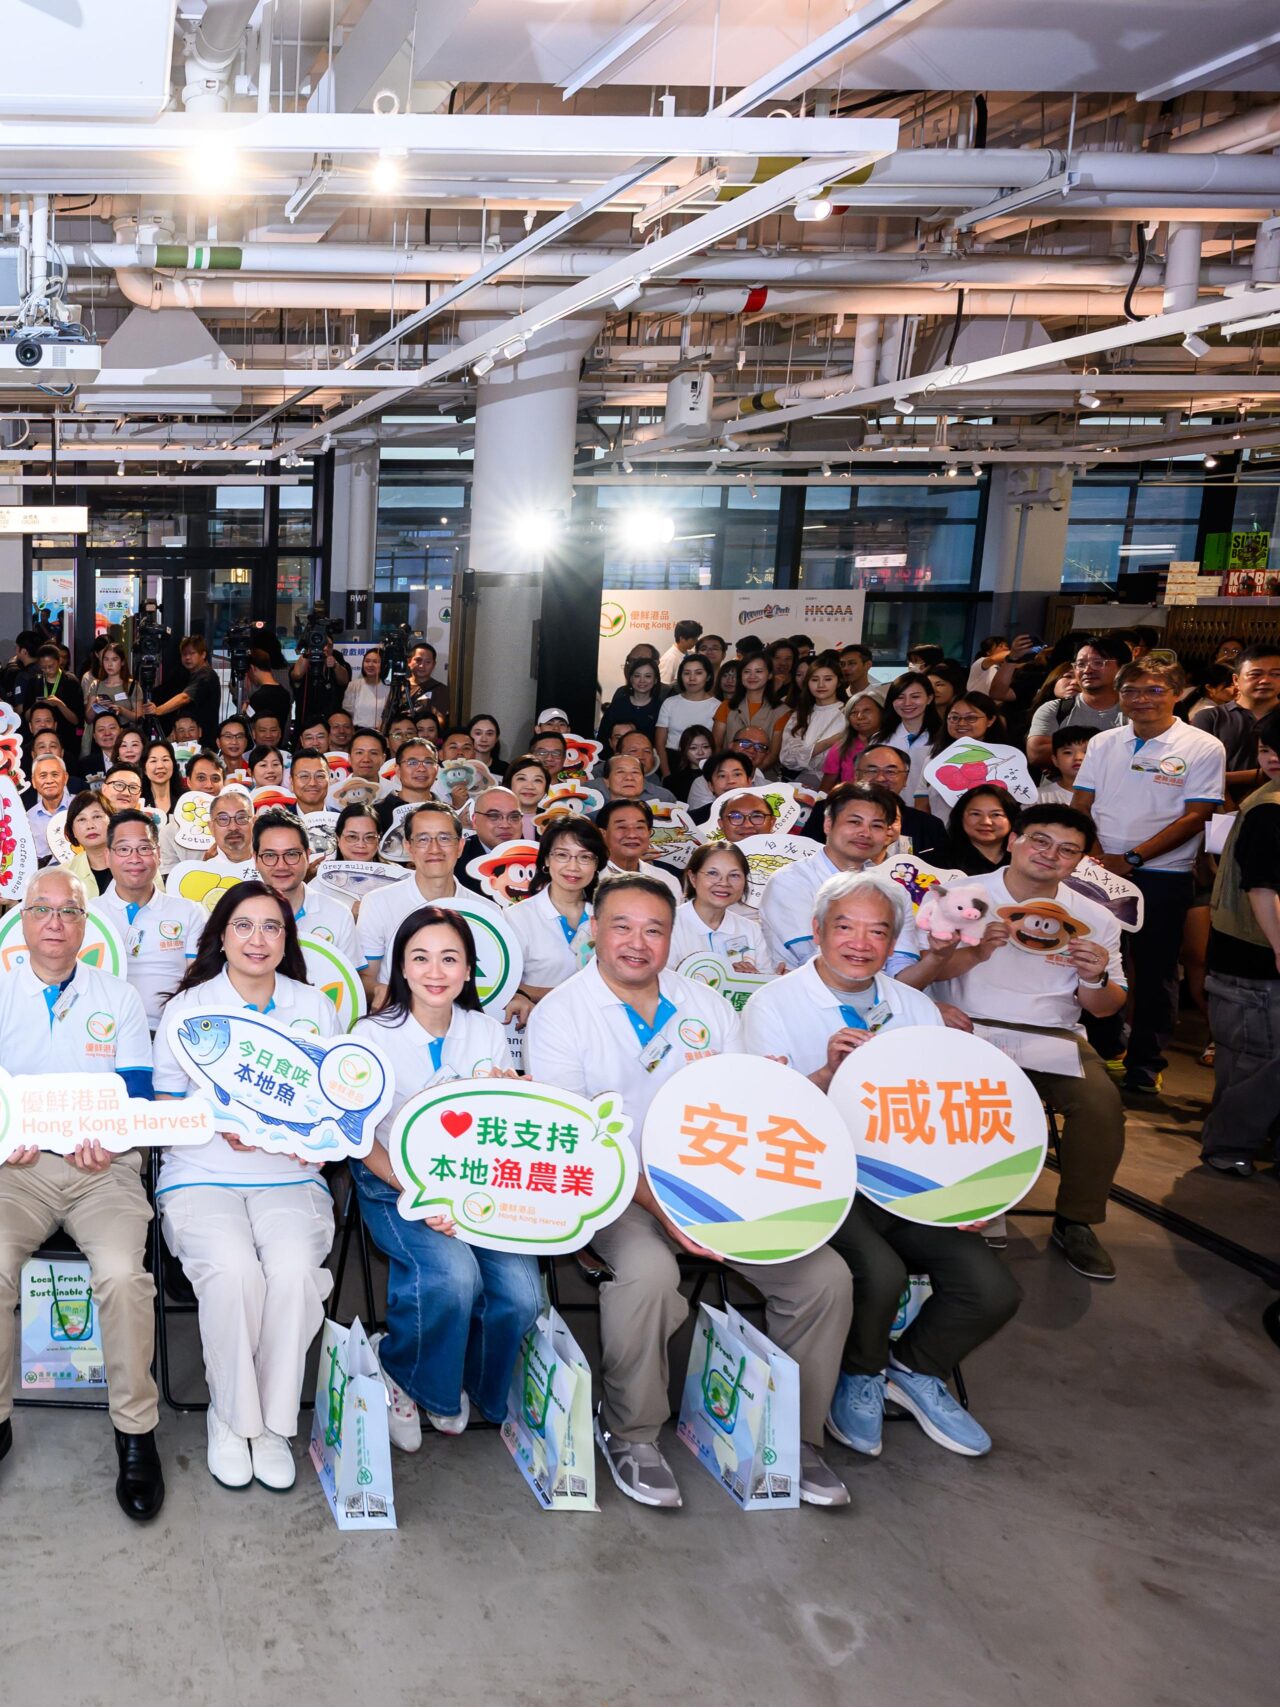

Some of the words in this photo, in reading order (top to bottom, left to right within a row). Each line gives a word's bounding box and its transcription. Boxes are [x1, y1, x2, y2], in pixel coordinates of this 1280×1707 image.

[630, 610, 669, 620] 優鮮港品
[805, 605, 853, 616] HKQAA
[630, 621, 650, 631] Hong
[652, 621, 672, 631] Kong
[180, 834, 211, 844] Lotus
[19, 837, 27, 868] Coffee
[322, 863, 342, 871] Grey
[345, 863, 374, 872] mullet
[11, 871, 25, 894] beans
[239, 1040, 312, 1089] 今日食咗
[233, 1063, 296, 1107] 本地魚
[21, 1087, 119, 1113] 優鮮港品
[860, 1078, 1016, 1145] 減碳
[22, 1117, 73, 1137] Hong
[79, 1116, 128, 1136] Kong
[133, 1112, 208, 1131] Harvest
[477, 1116, 579, 1154] 我支持
[678, 1102, 827, 1190] 安全
[428, 1154, 594, 1197] 本地漁農業
